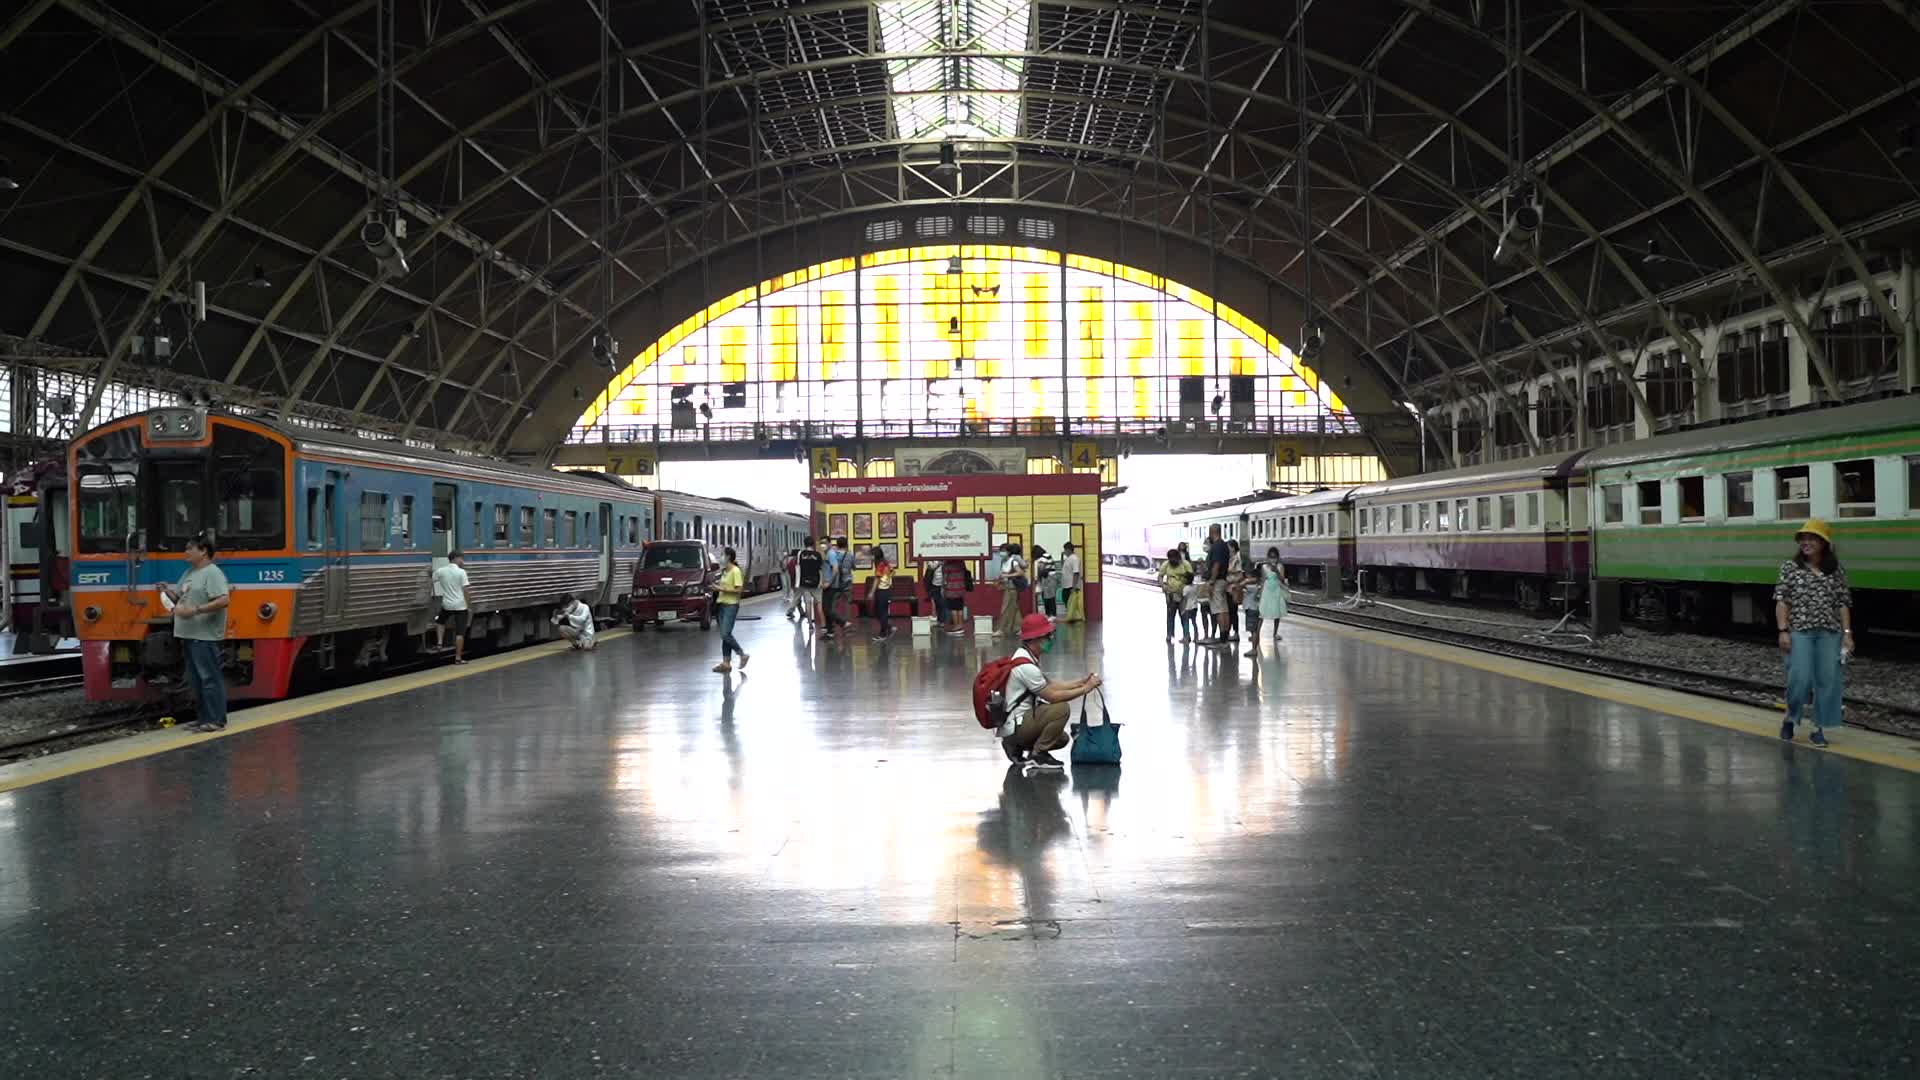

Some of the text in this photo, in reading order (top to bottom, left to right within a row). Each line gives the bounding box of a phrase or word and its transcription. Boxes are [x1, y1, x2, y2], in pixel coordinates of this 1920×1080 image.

[1077, 447, 1092, 466] 4
[1282, 447, 1297, 466] 3
[610, 457, 649, 473] 7 6
[78, 572, 111, 584] SRT
[258, 570, 284, 581] 1235
